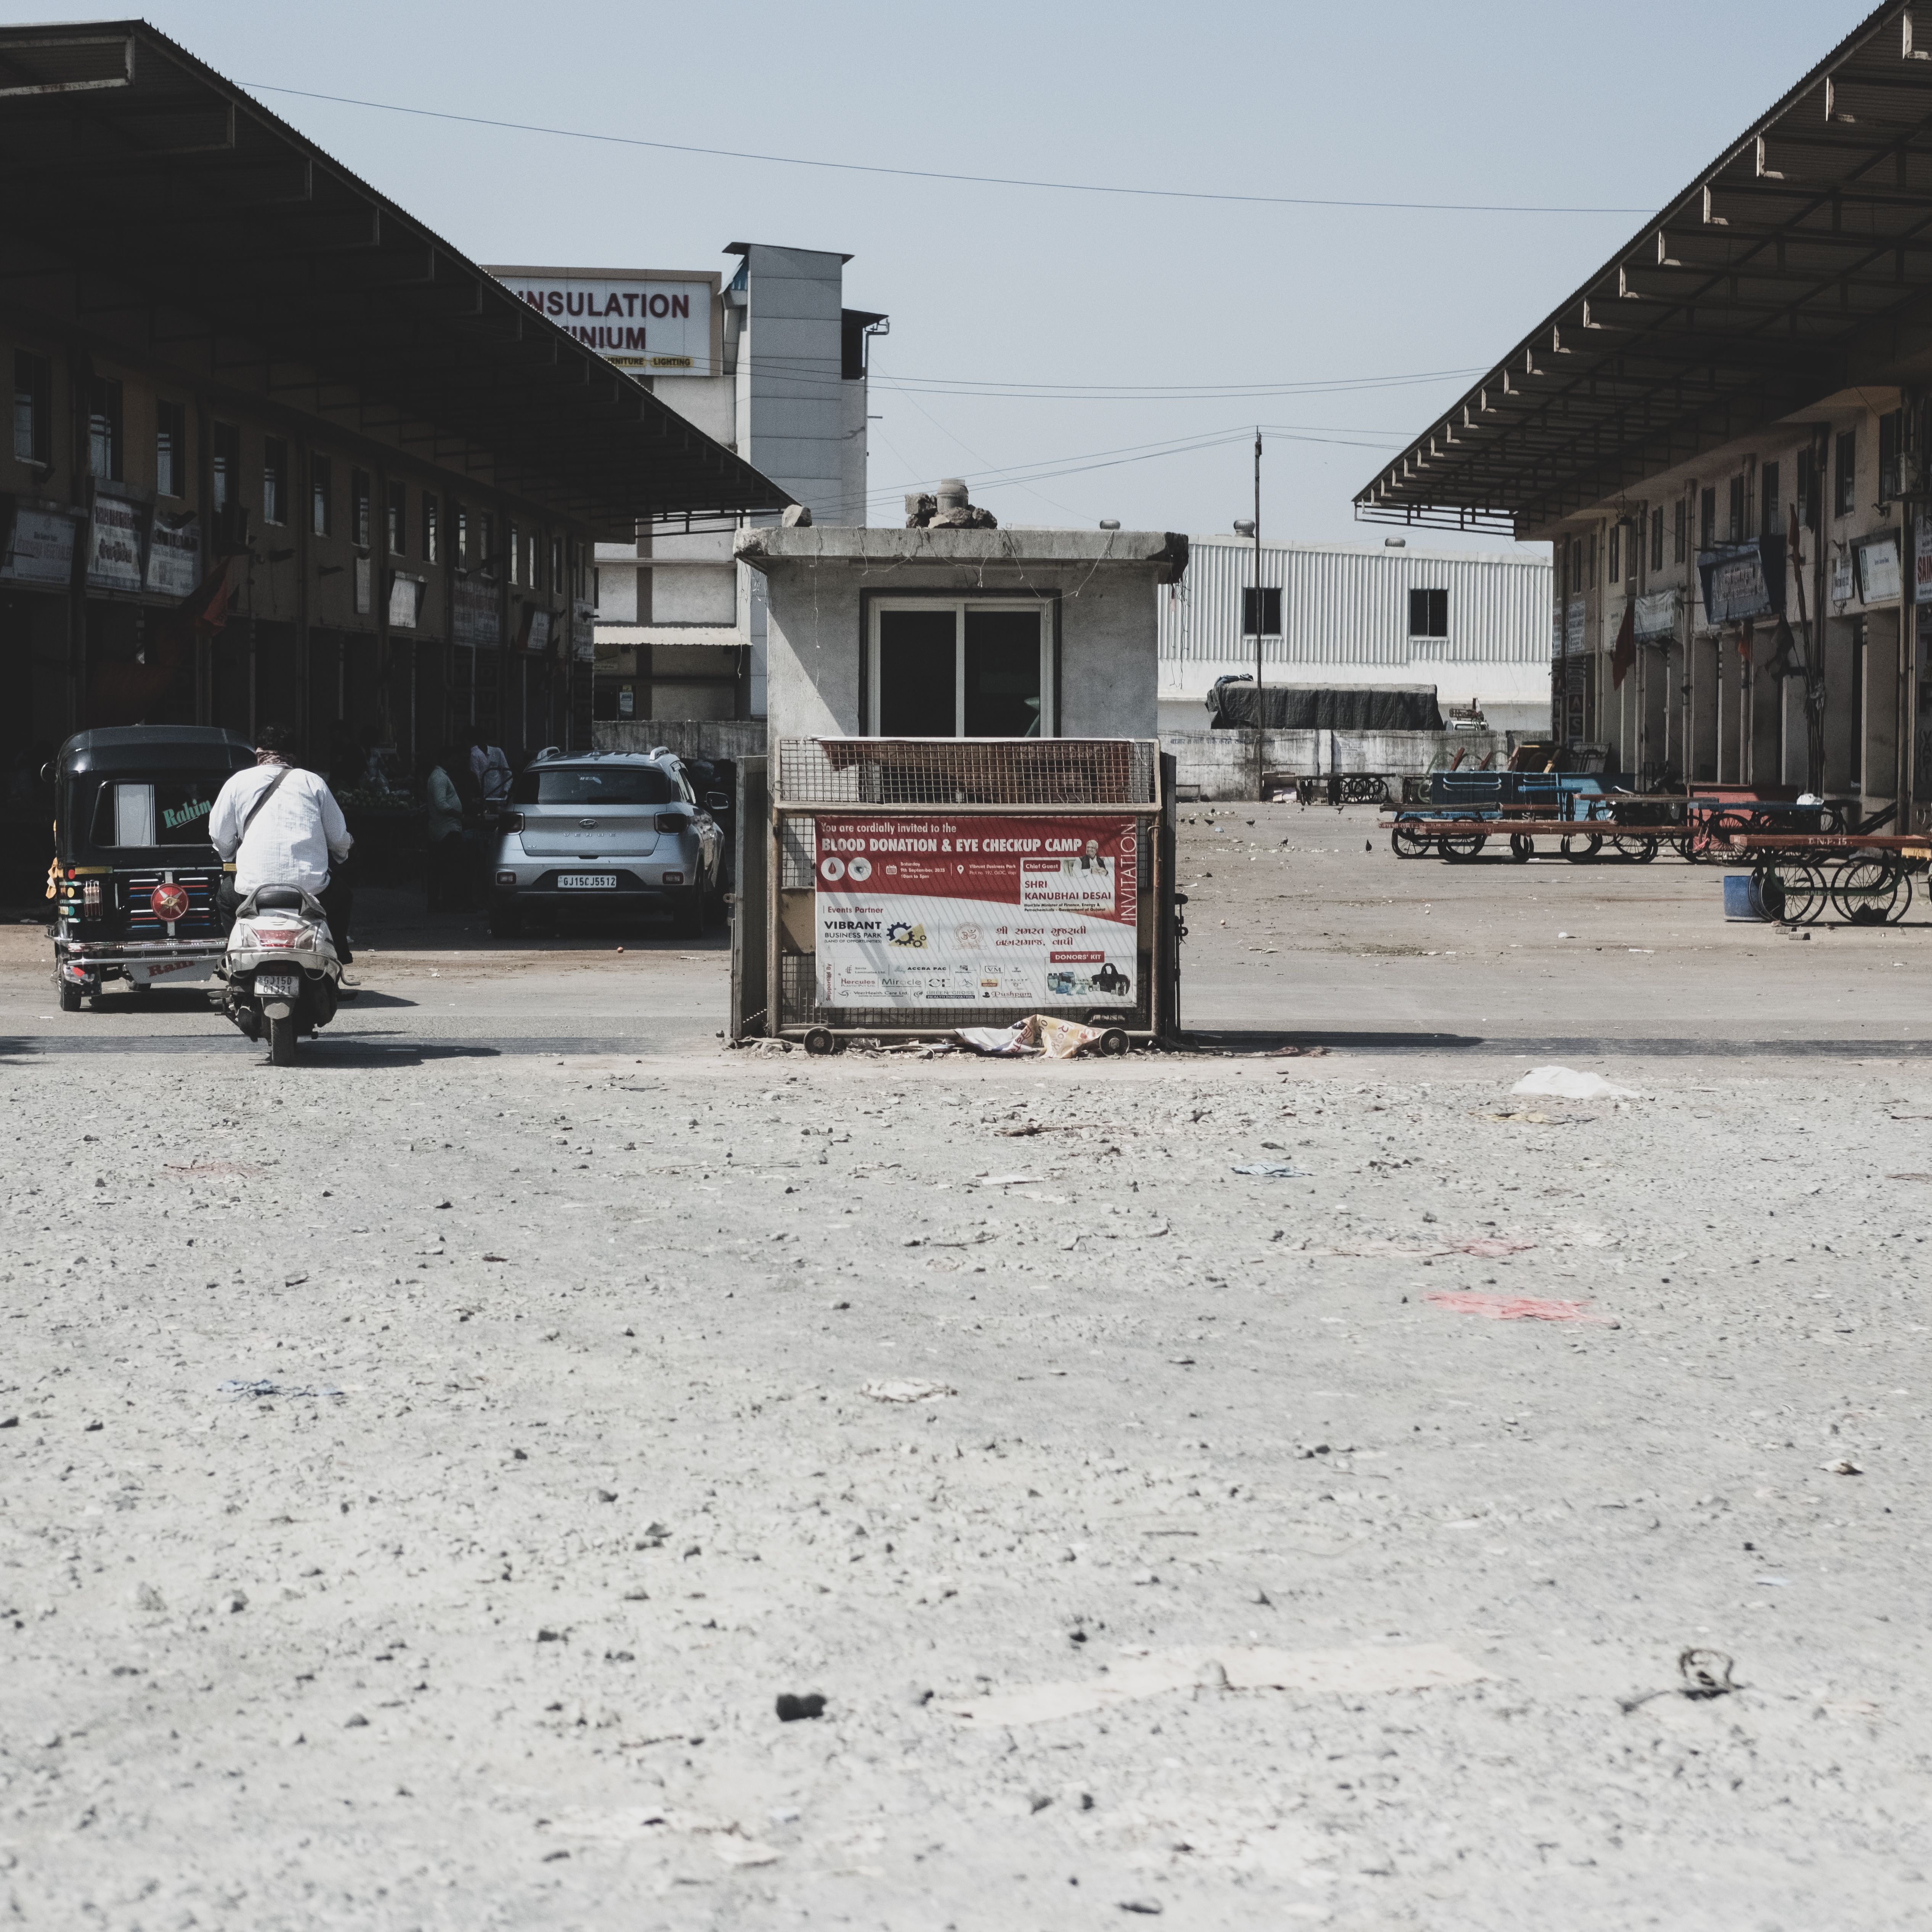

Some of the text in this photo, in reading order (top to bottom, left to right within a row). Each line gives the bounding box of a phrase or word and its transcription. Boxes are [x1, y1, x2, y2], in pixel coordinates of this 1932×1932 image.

[518, 291, 689, 318] NSULATION
[162, 799, 212, 828] Rahim
[821, 822, 956, 834] You are cordially invited to the
[822, 838, 1082, 852] BLOOD DONATION & EYE CHECKUP CAMP
[1120, 824, 1136, 920] INVITATION
[563, 877, 616, 886] GJ15CJ5512
[1083, 892, 1111, 900] DESAI
[824, 921, 882, 929] VIBRANT
[996, 926, 1008, 934] શ્રી
[1051, 926, 1086, 937] ગુજરાતી
[1052, 937, 1073, 945] વાપી
[264, 976, 292, 985] GJ15D
